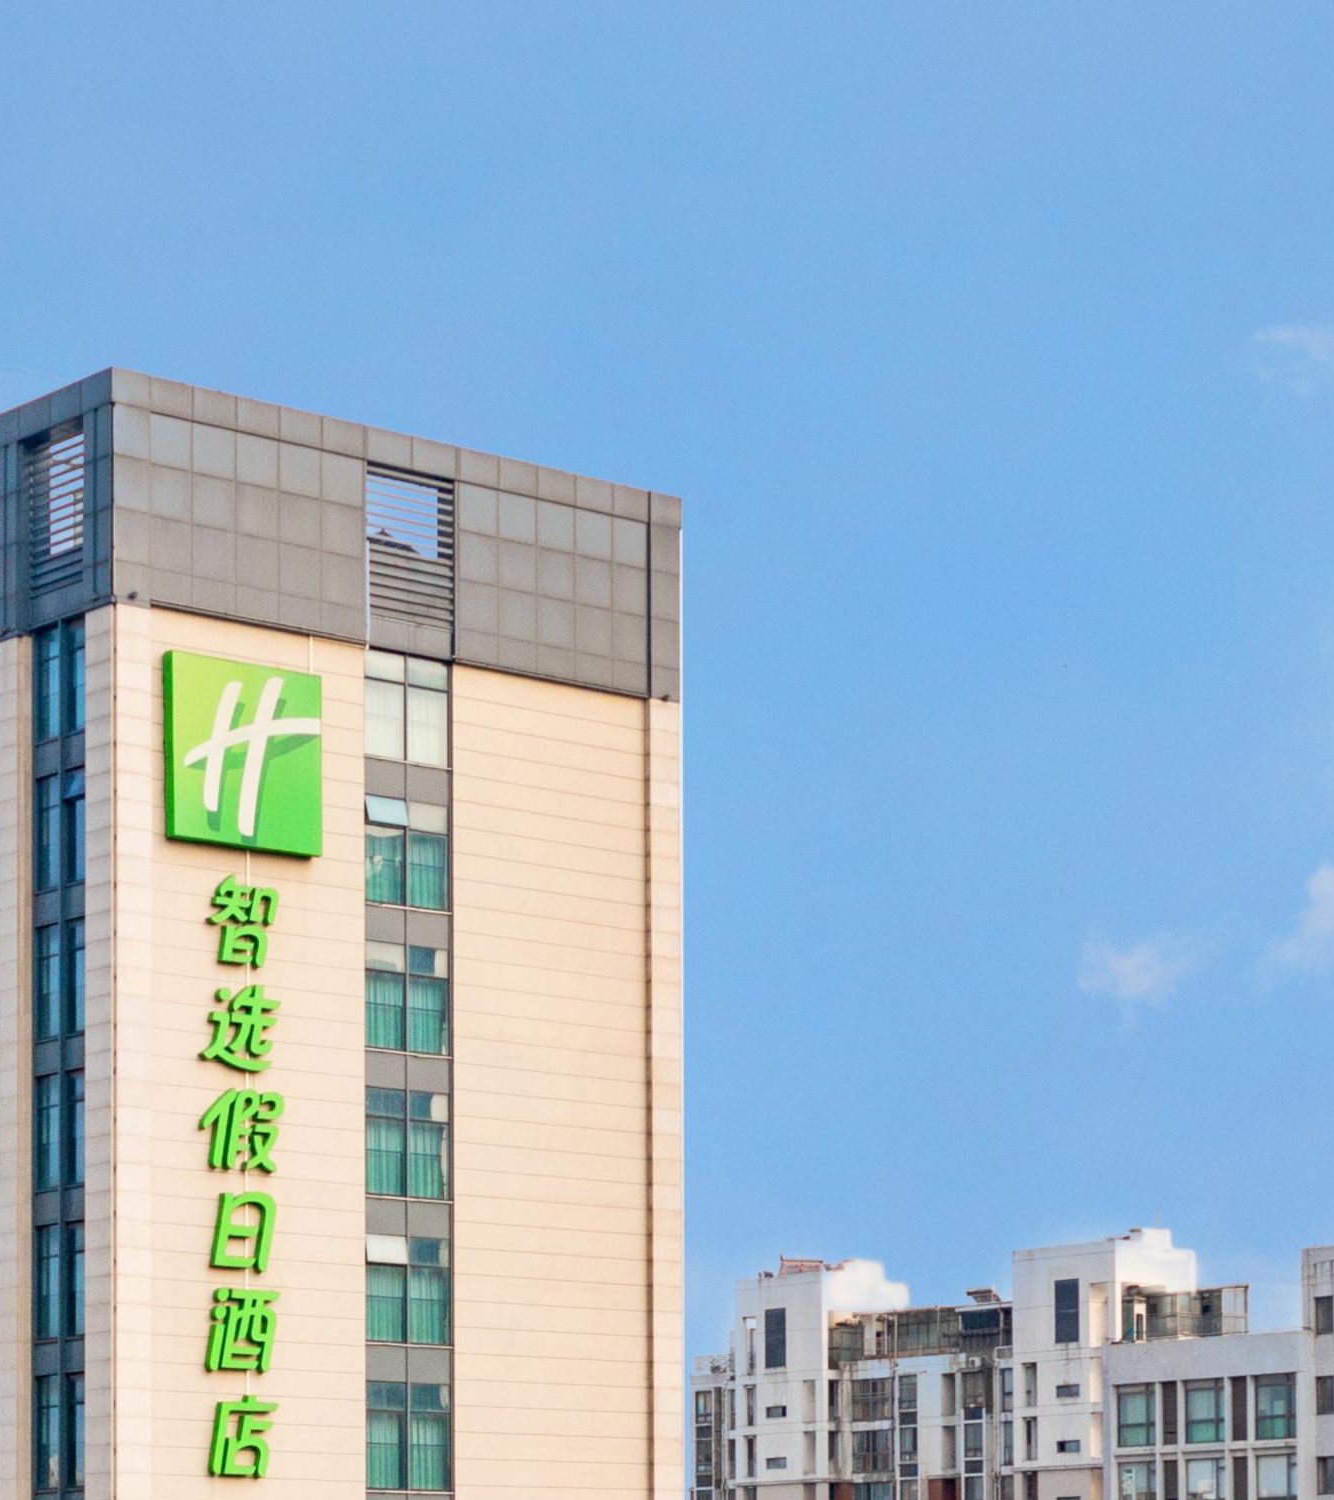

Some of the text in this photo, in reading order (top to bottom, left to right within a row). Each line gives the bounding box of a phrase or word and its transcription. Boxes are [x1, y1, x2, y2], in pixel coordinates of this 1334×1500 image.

[198, 872, 284, 1480] 智选假日酒店
